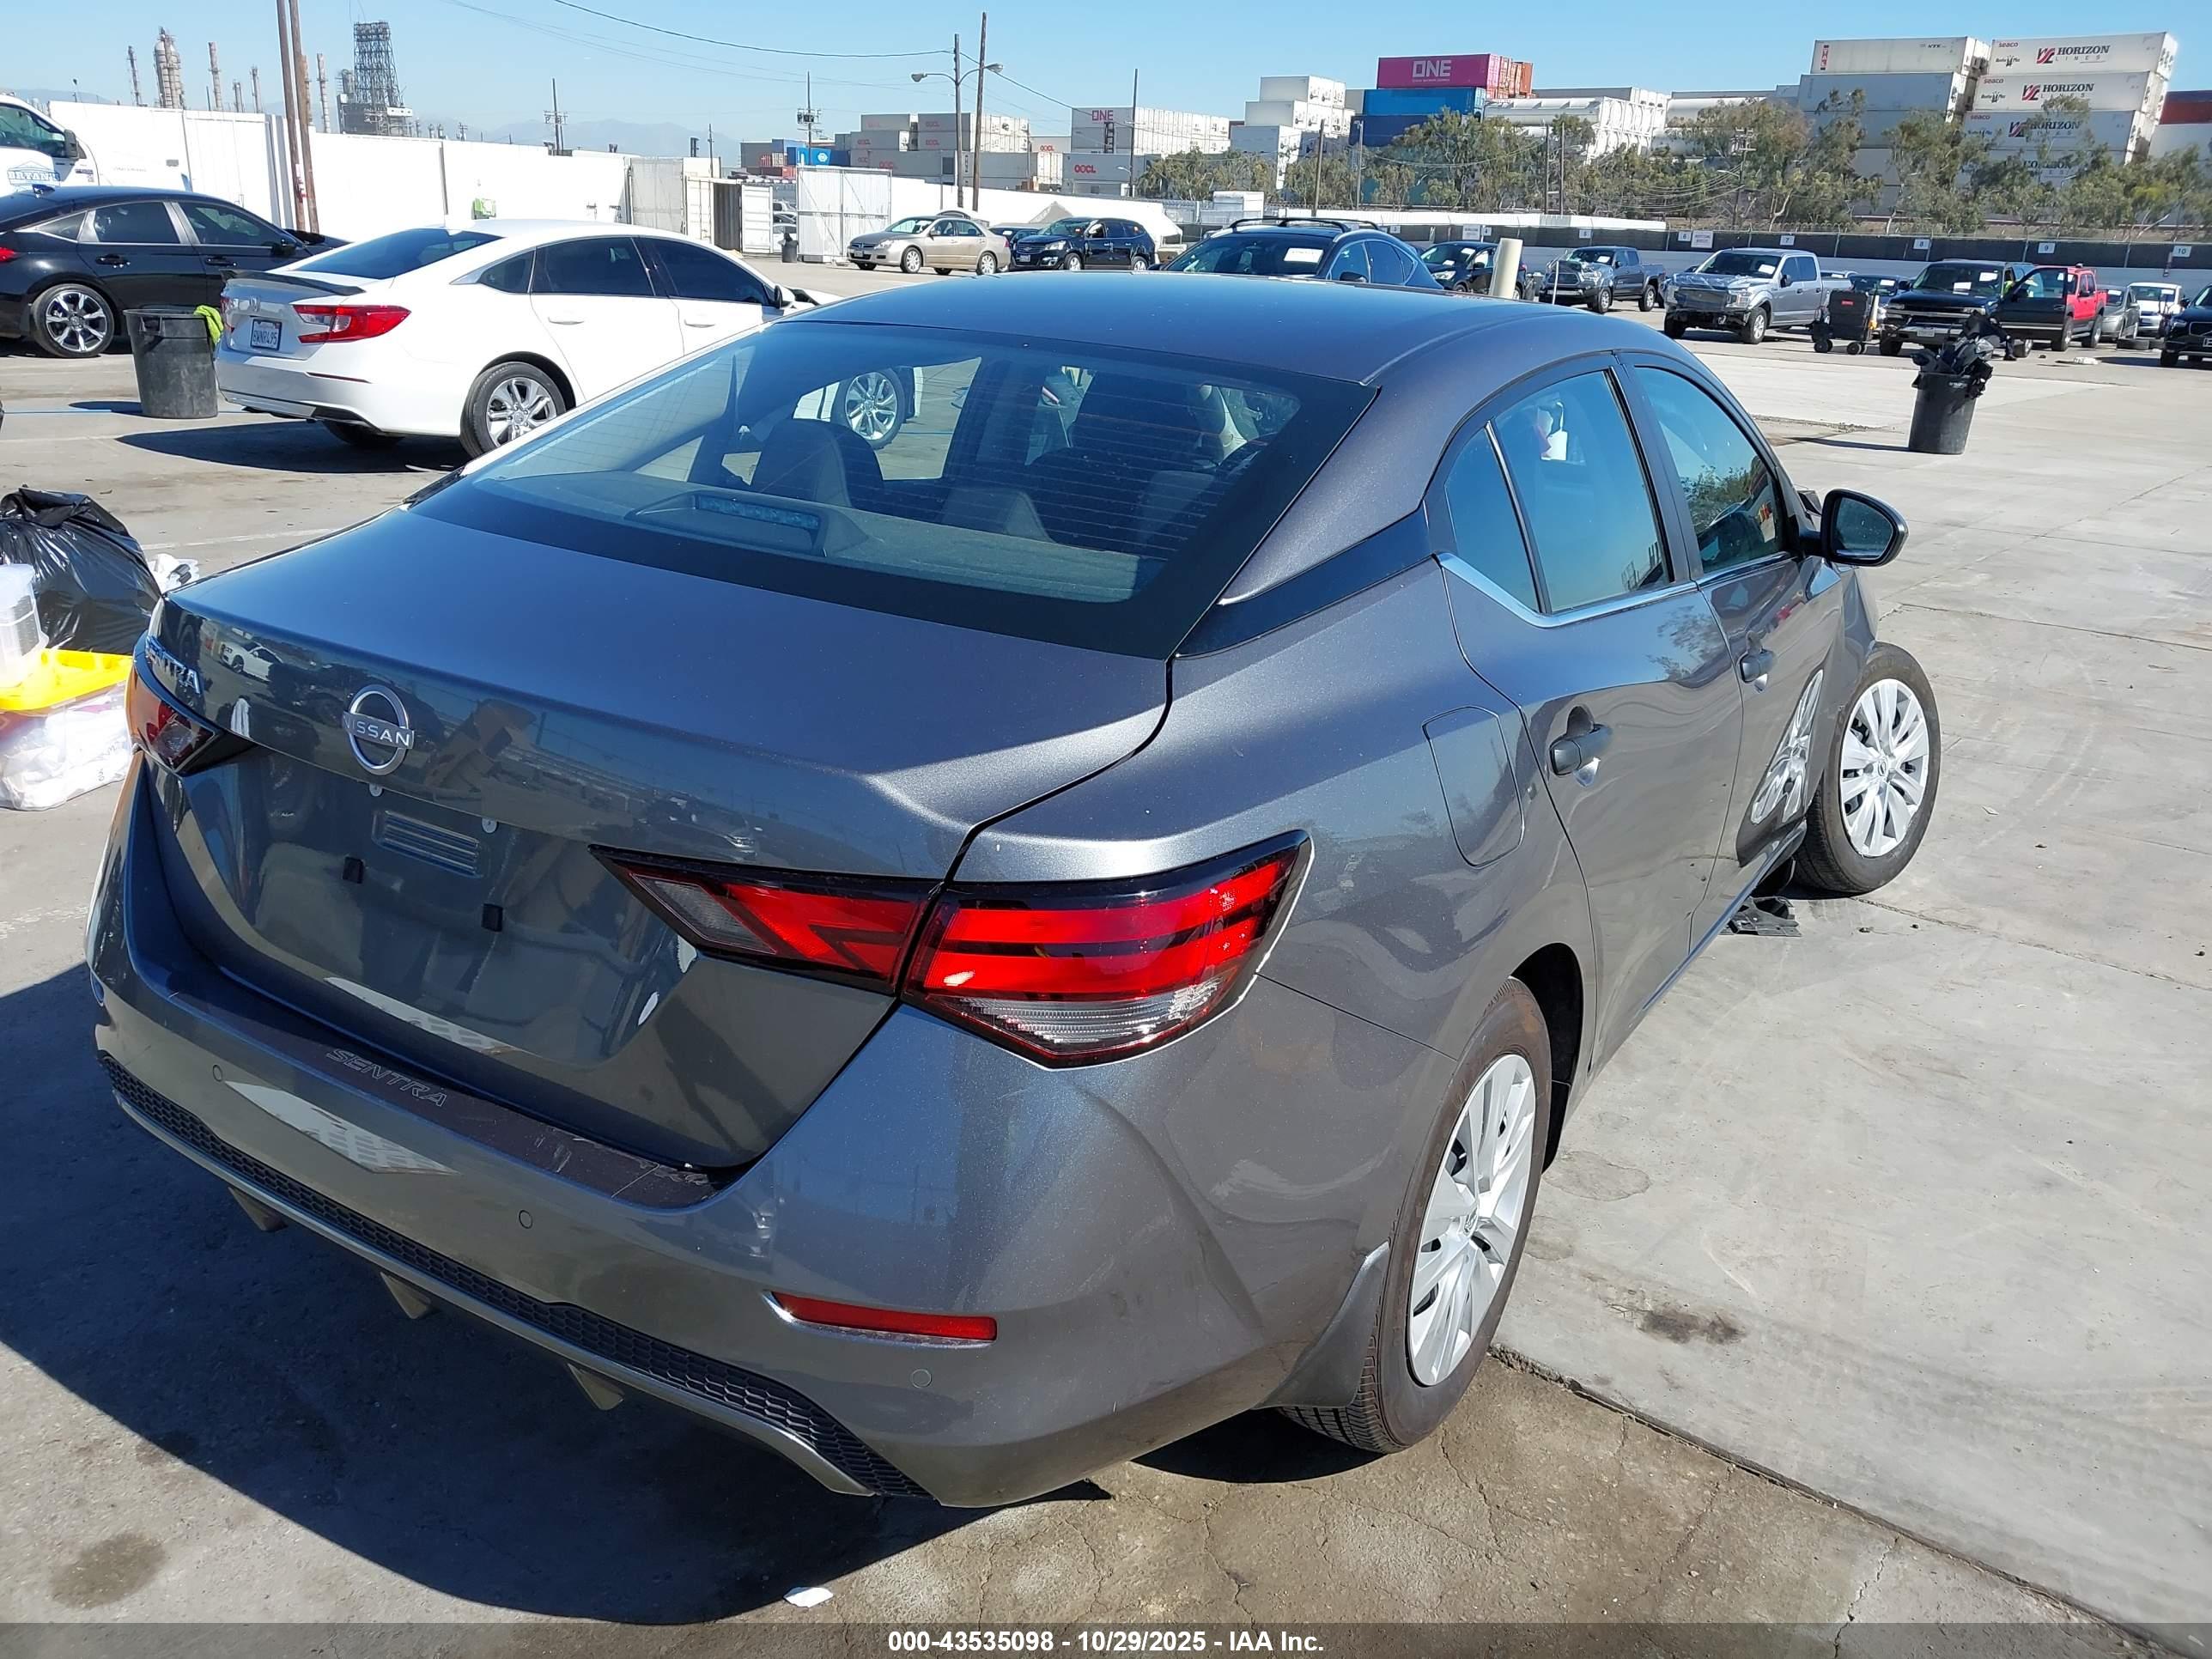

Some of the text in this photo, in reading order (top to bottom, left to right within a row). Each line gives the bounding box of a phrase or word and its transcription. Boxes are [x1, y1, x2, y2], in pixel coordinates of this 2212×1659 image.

[2057, 46, 2111, 56] HORIZON
[1413, 60, 1451, 77] ONE
[2042, 83, 2095, 94] HORIZON
[1091, 109, 1114, 121] ONE
[1074, 164, 1097, 173] OOCL
[343, 715, 410, 746] NISSAN
[325, 1048, 447, 1107] SENTRA
